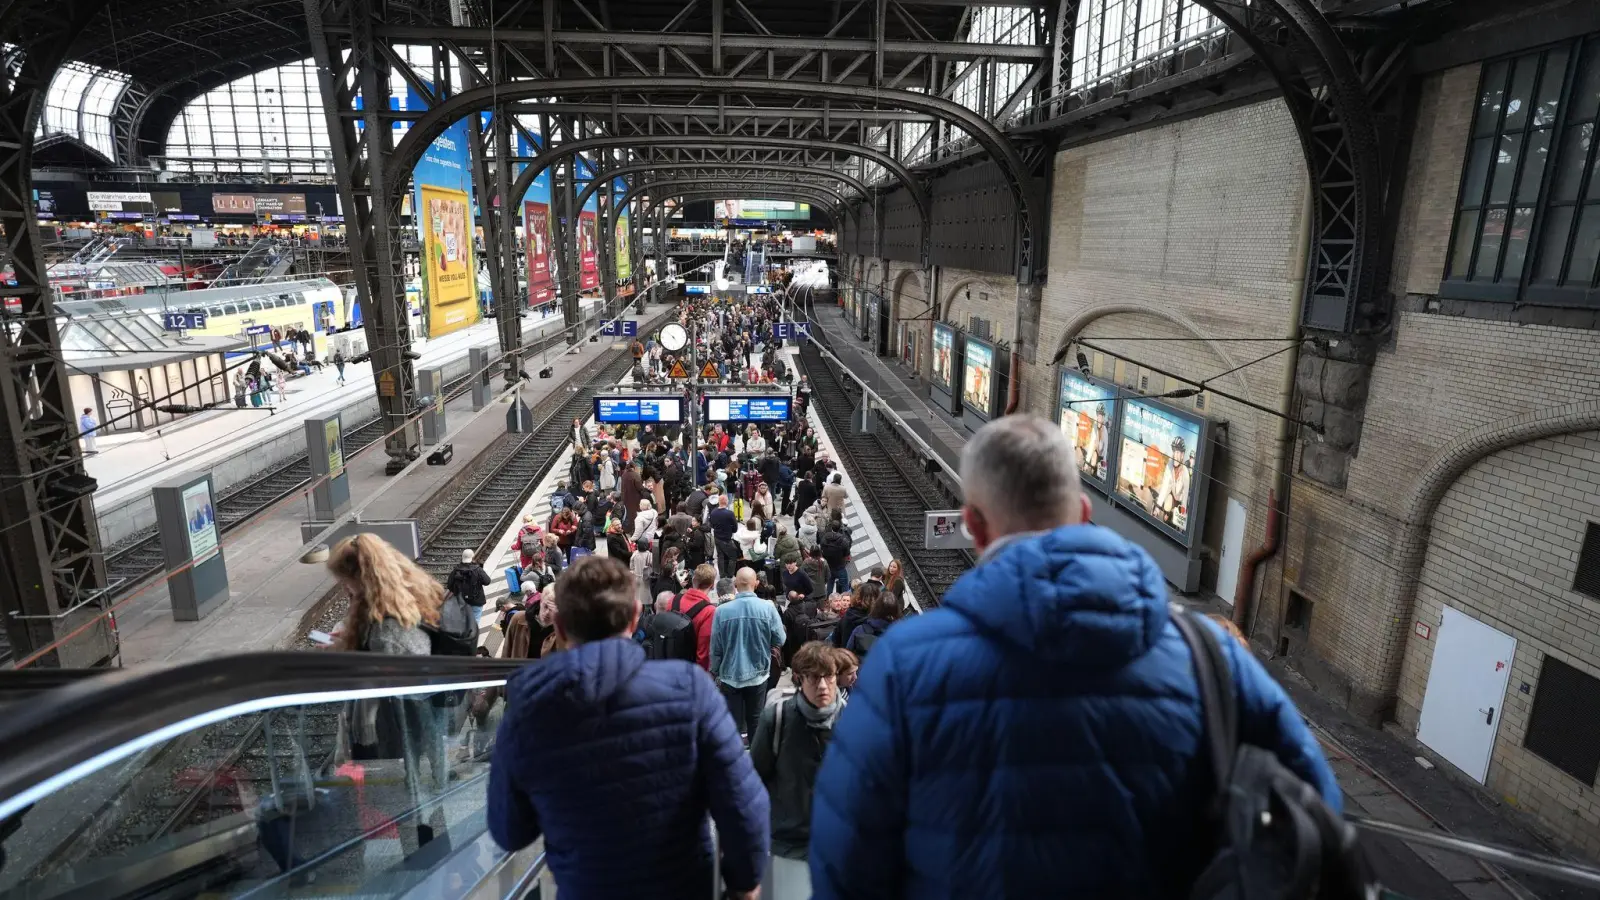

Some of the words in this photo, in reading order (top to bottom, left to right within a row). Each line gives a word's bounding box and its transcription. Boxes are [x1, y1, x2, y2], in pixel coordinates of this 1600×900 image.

[170, 316, 186, 328] 12
[195, 316, 203, 328] E
[602, 322, 614, 332] 13
[622, 322, 630, 334] E
[779, 324, 786, 336] E
[1127, 402, 1140, 415] Weil
[1153, 413, 1173, 430] Körper
